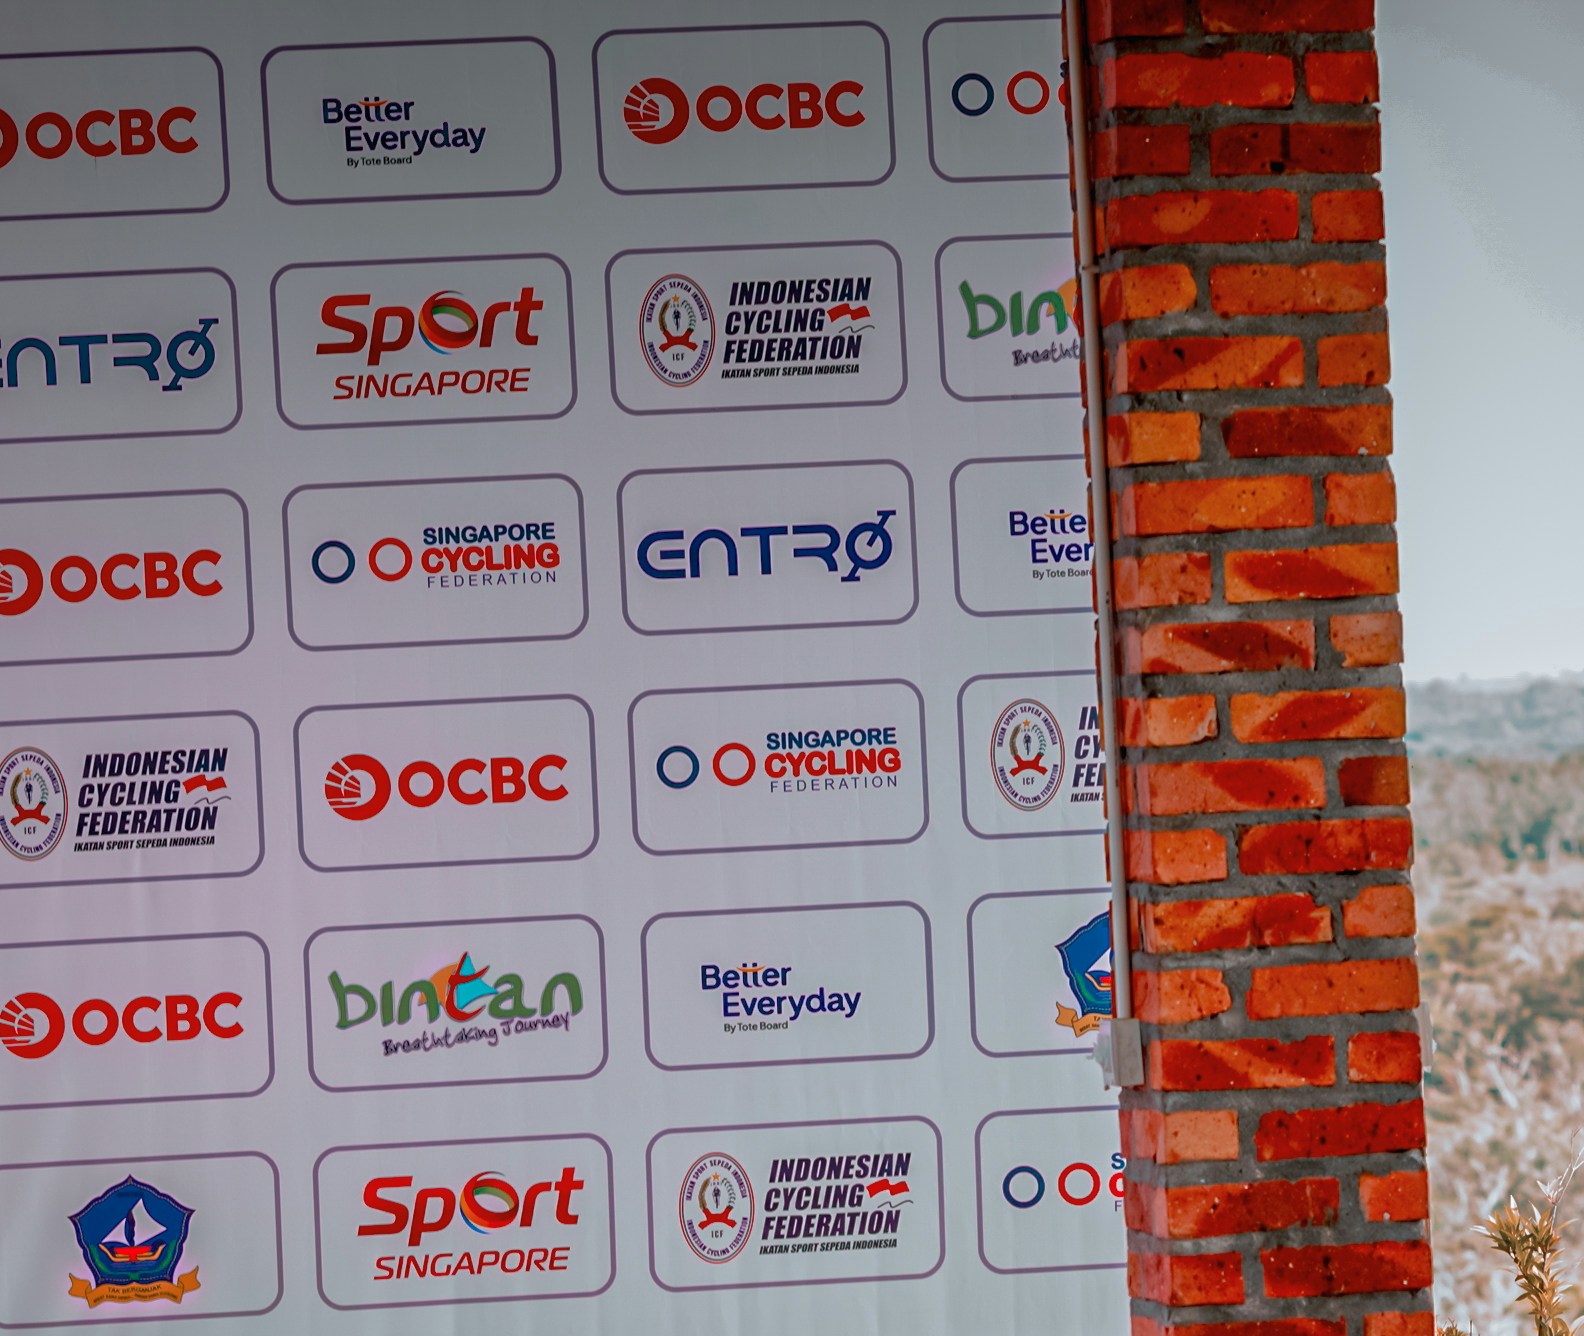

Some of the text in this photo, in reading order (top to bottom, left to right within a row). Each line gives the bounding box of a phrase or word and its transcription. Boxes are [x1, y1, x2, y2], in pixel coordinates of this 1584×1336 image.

[322, 96, 414, 123] Better
[696, 80, 865, 132] OCBC
[25, 106, 198, 159] OCBC
[344, 121, 485, 155] Everyday
[346, 155, 412, 168] By Tote Board
[729, 277, 871, 306] INDONESIAN
[316, 287, 543, 366] Sport
[725, 308, 825, 335] CYCLING
[723, 335, 862, 363] FEDERATION
[333, 368, 531, 400] SINGAPORE
[721, 364, 859, 378] IKATAN SPORT SEPEDA INDONESIA
[423, 522, 555, 545] SINGAPORE
[1009, 509, 1087, 536] Bette
[421, 542, 560, 573] CYCLING
[1031, 538, 1093, 563] Ever
[50, 549, 223, 602] OCBC
[427, 571, 555, 588] FEDERATION
[1046, 568, 1066, 578] Tote
[766, 727, 896, 750] SINGAPORE
[82, 747, 227, 778] INDONESIAN
[764, 747, 901, 778] CYCLING
[78, 779, 181, 808] CYCLING
[398, 754, 568, 807] OCBC
[770, 775, 896, 792] FEDERATION
[1022, 777, 1034, 785] ICF
[76, 806, 218, 836] FEDERATION
[74, 835, 215, 851] IKATAN SPORT SEPEDA INDONESIA
[329, 952, 582, 1028] bintan
[701, 962, 791, 990] Better
[723, 987, 861, 1020] Everyday
[72, 992, 244, 1046] OCBC
[723, 1021, 788, 1033] By Tote Board
[381, 1012, 569, 1056] Breathtaking Journey
[769, 1152, 911, 1183] INDONESIAN
[357, 1167, 584, 1246] Sport
[764, 1183, 864, 1212] CYCLING
[761, 1209, 900, 1240] FEDERATION
[759, 1238, 897, 1254] IKATAN SPORT SEPEDA INDONESIA
[374, 1247, 570, 1280] SINGAPORE
